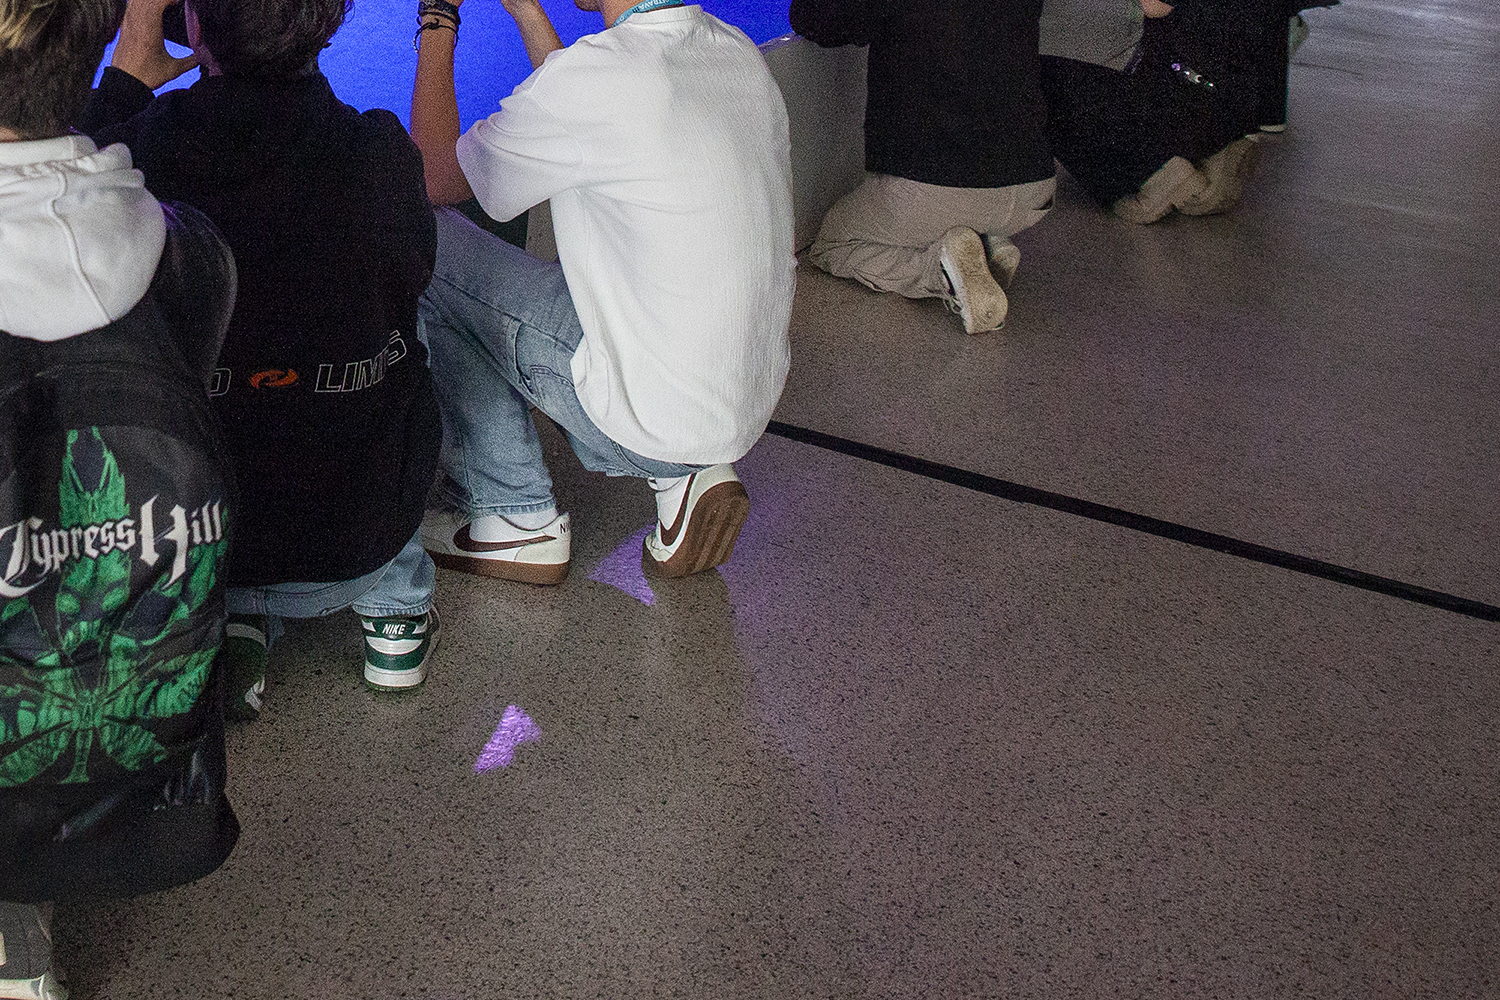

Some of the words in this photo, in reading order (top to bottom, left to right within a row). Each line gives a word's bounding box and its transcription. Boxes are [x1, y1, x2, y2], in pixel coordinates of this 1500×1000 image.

[314, 329, 408, 393] LIMS
[139, 494, 224, 591] Hill
[382, 623, 406, 635] NIKE
